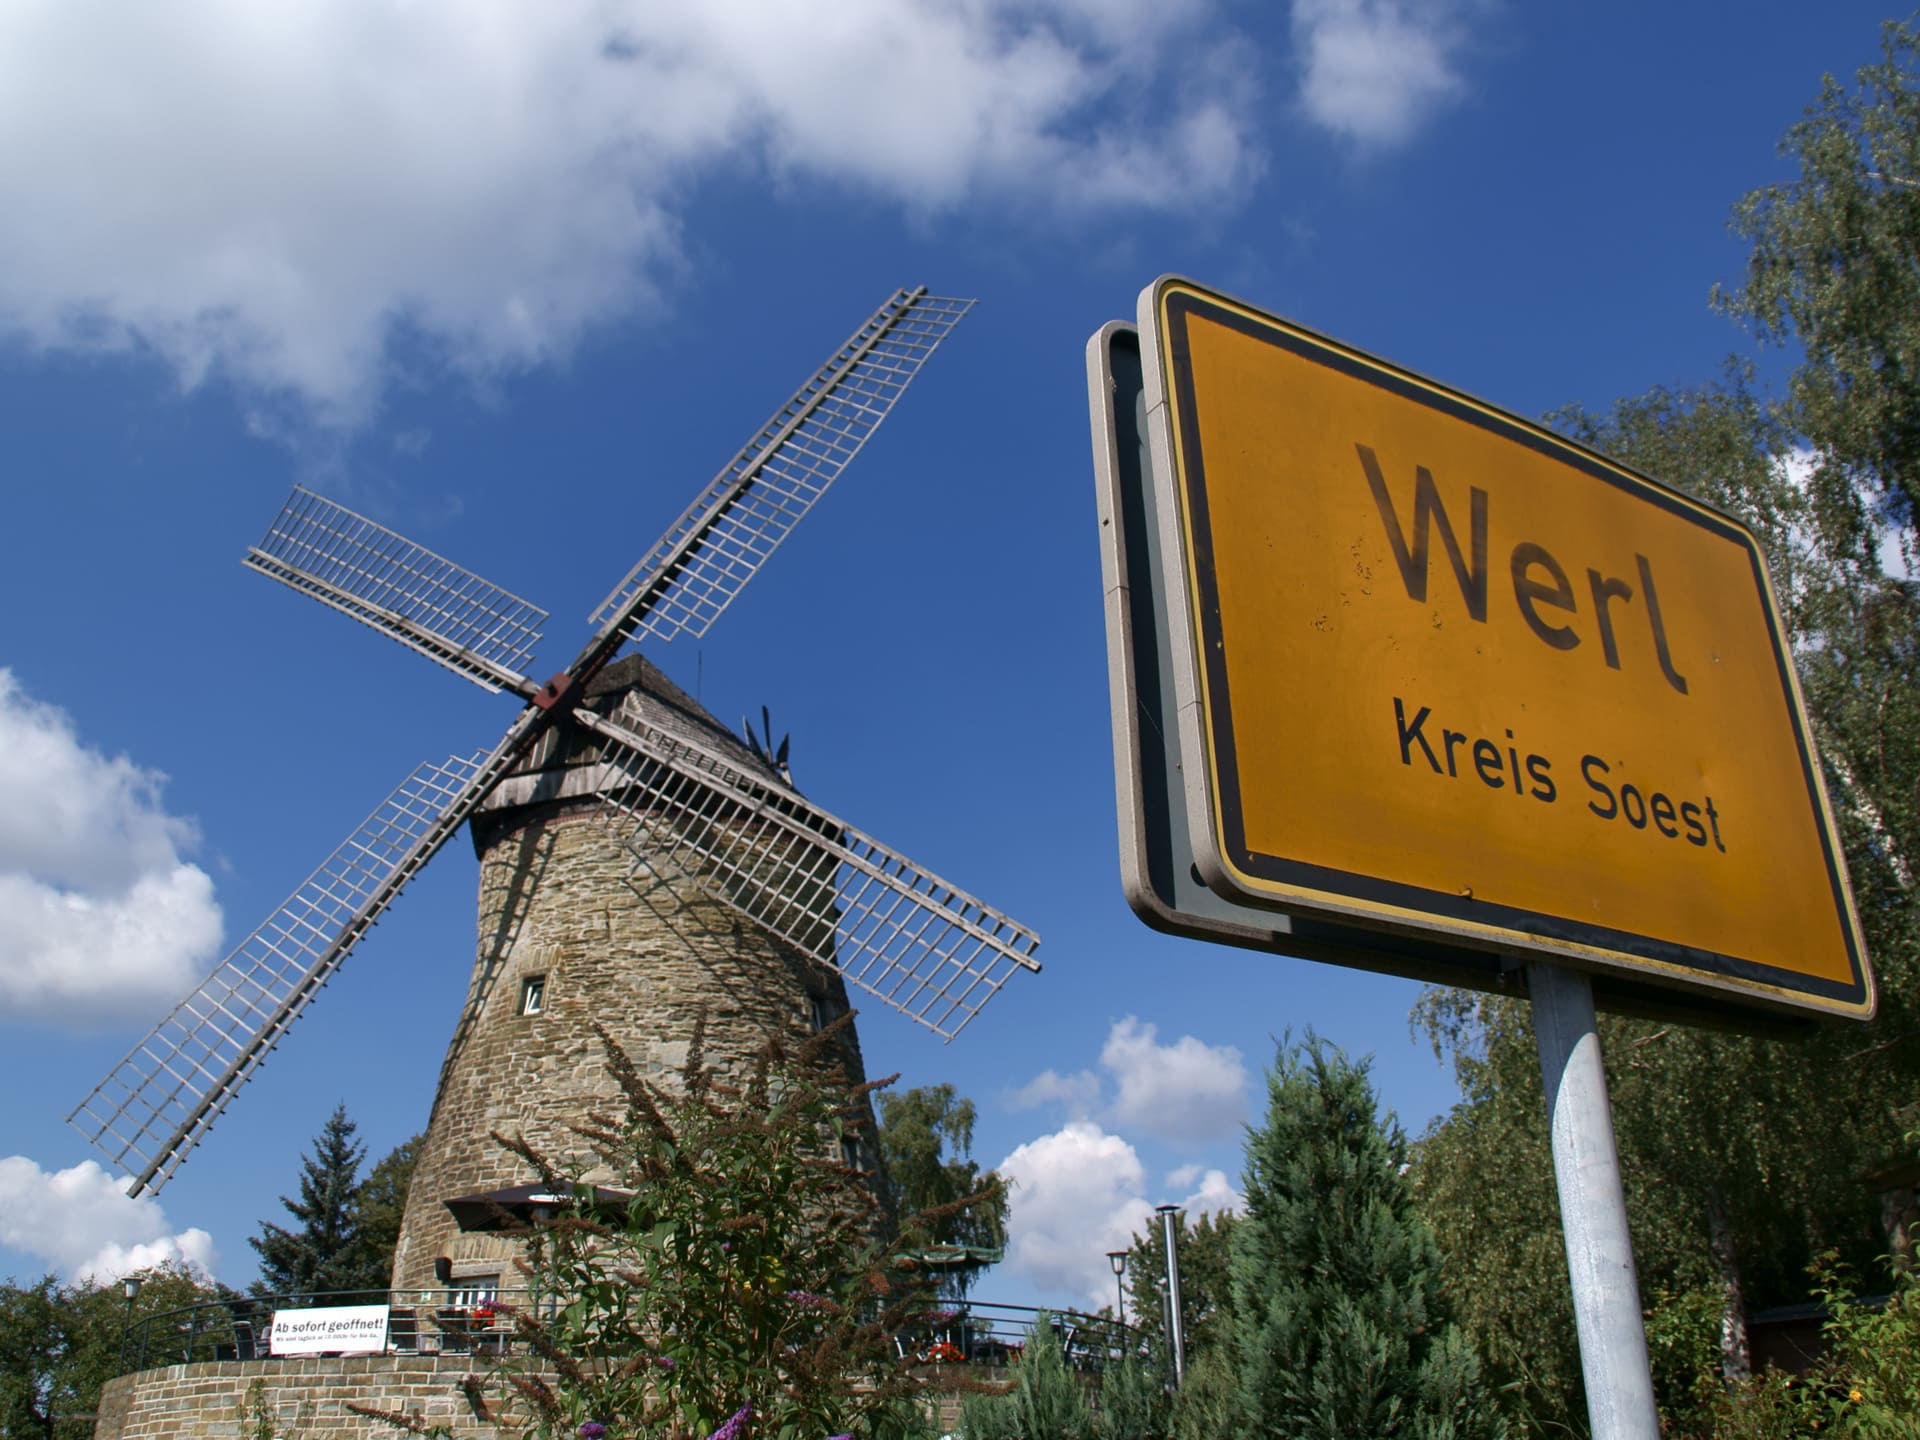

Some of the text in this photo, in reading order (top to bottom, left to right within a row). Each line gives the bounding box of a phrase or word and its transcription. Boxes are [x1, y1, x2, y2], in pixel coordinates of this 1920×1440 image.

[1356, 443, 1688, 696] Werl
[1393, 697, 1727, 854] Kreis Soest
[275, 1322, 289, 1333] Ab
[292, 1320, 327, 1333] sofort
